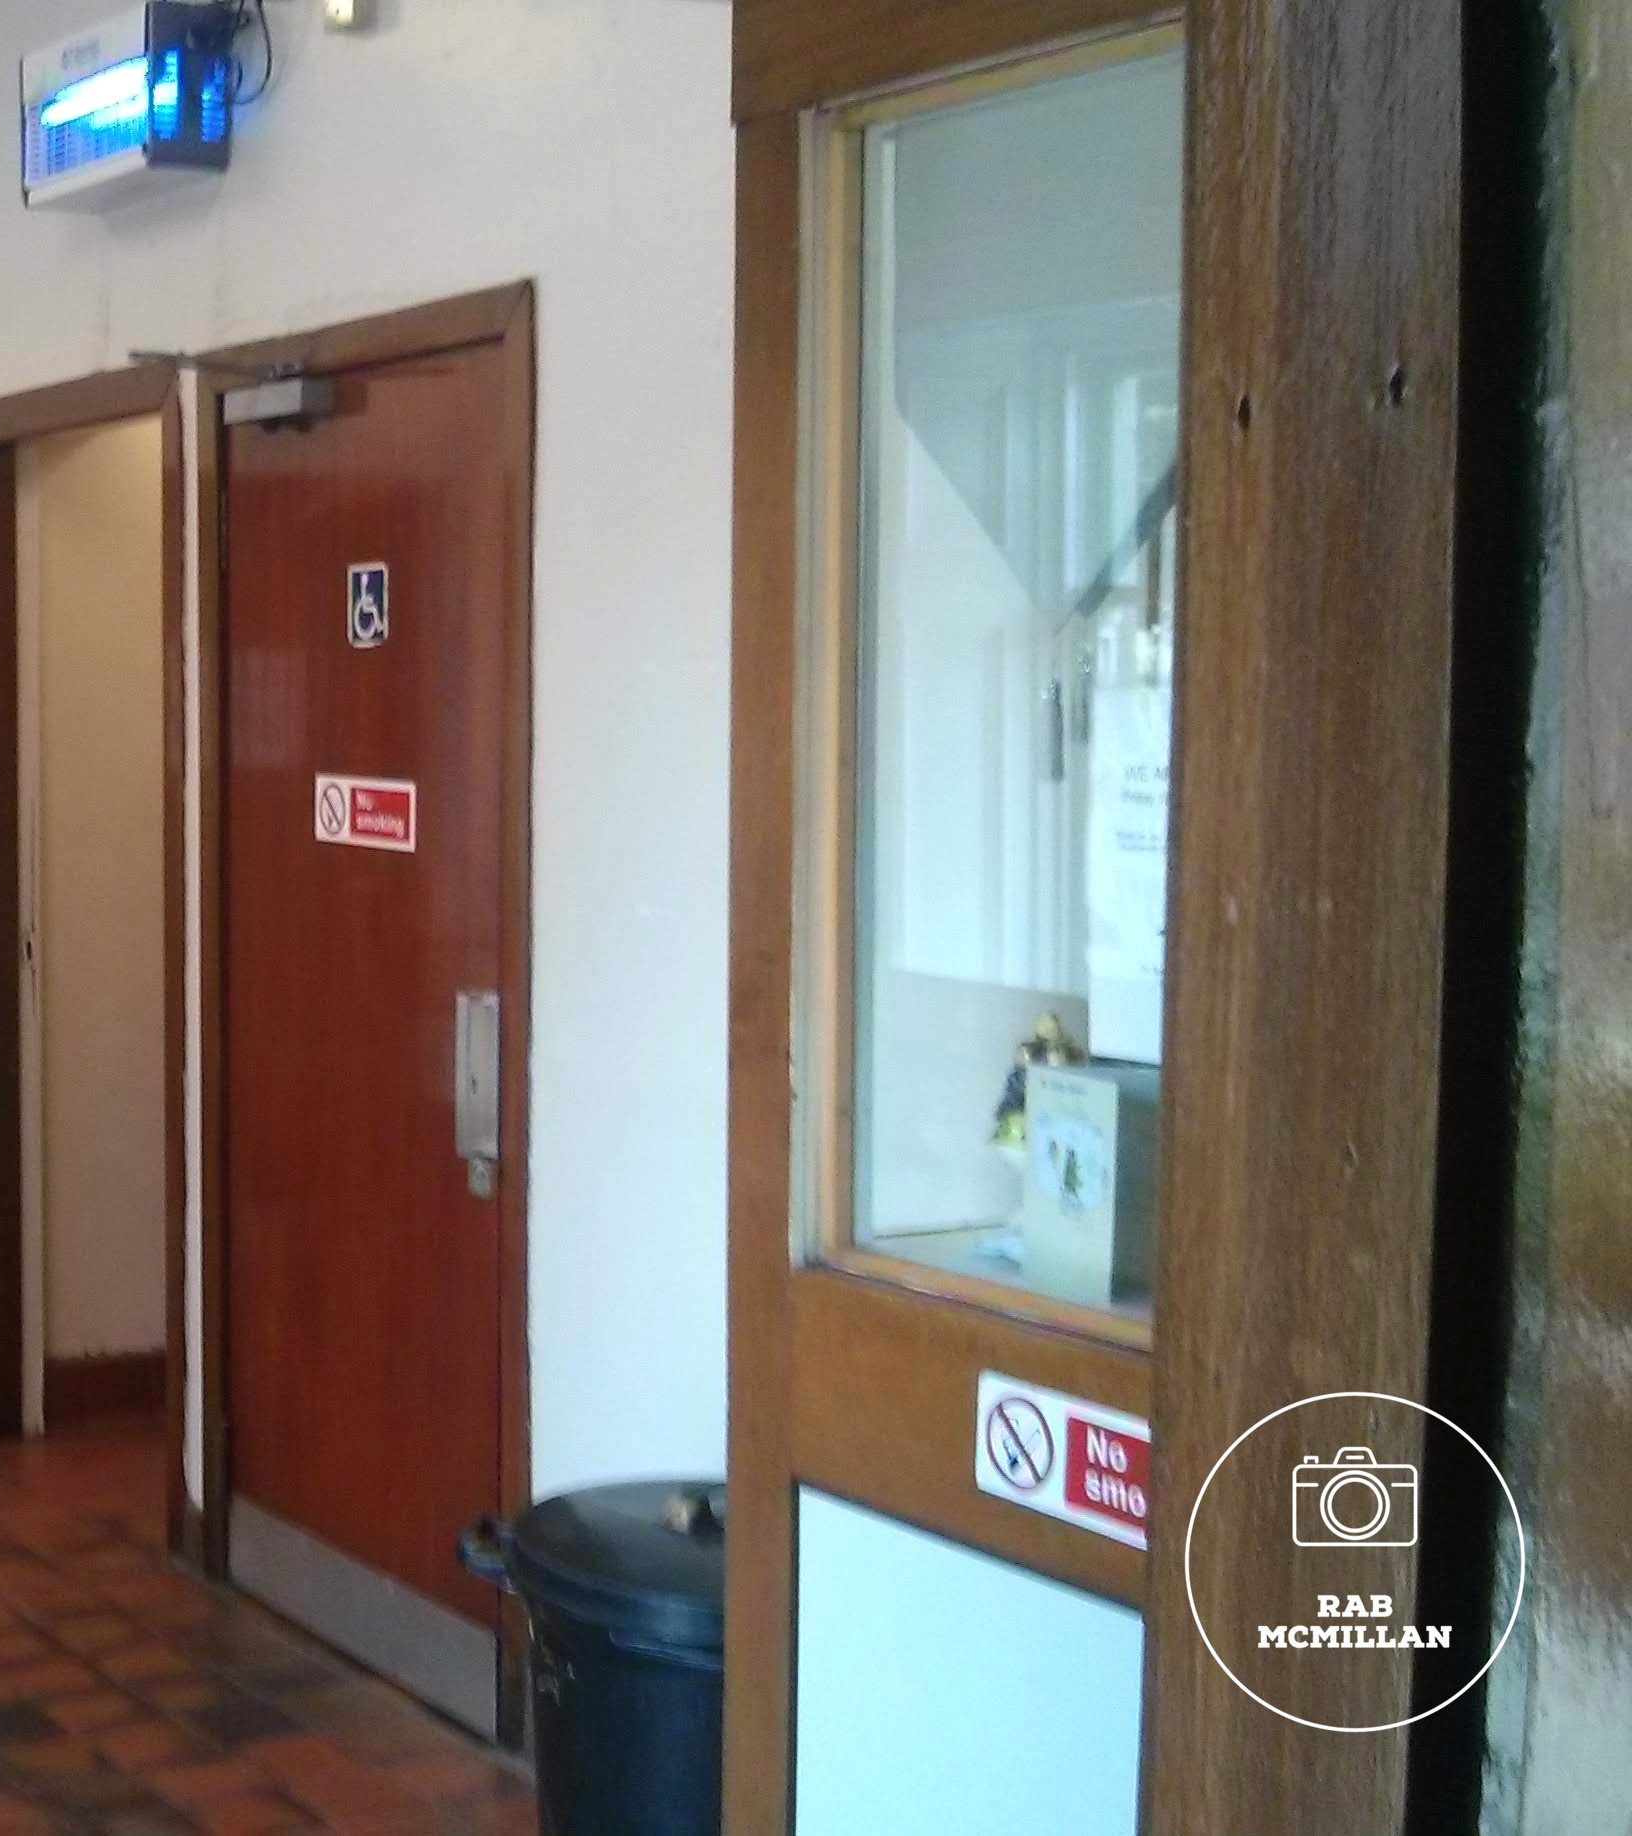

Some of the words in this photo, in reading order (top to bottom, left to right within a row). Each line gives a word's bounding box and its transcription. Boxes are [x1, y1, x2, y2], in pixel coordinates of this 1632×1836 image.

[355, 788, 375, 812] No
[355, 814, 404, 839] smoking
[1087, 1425, 1127, 1473] No
